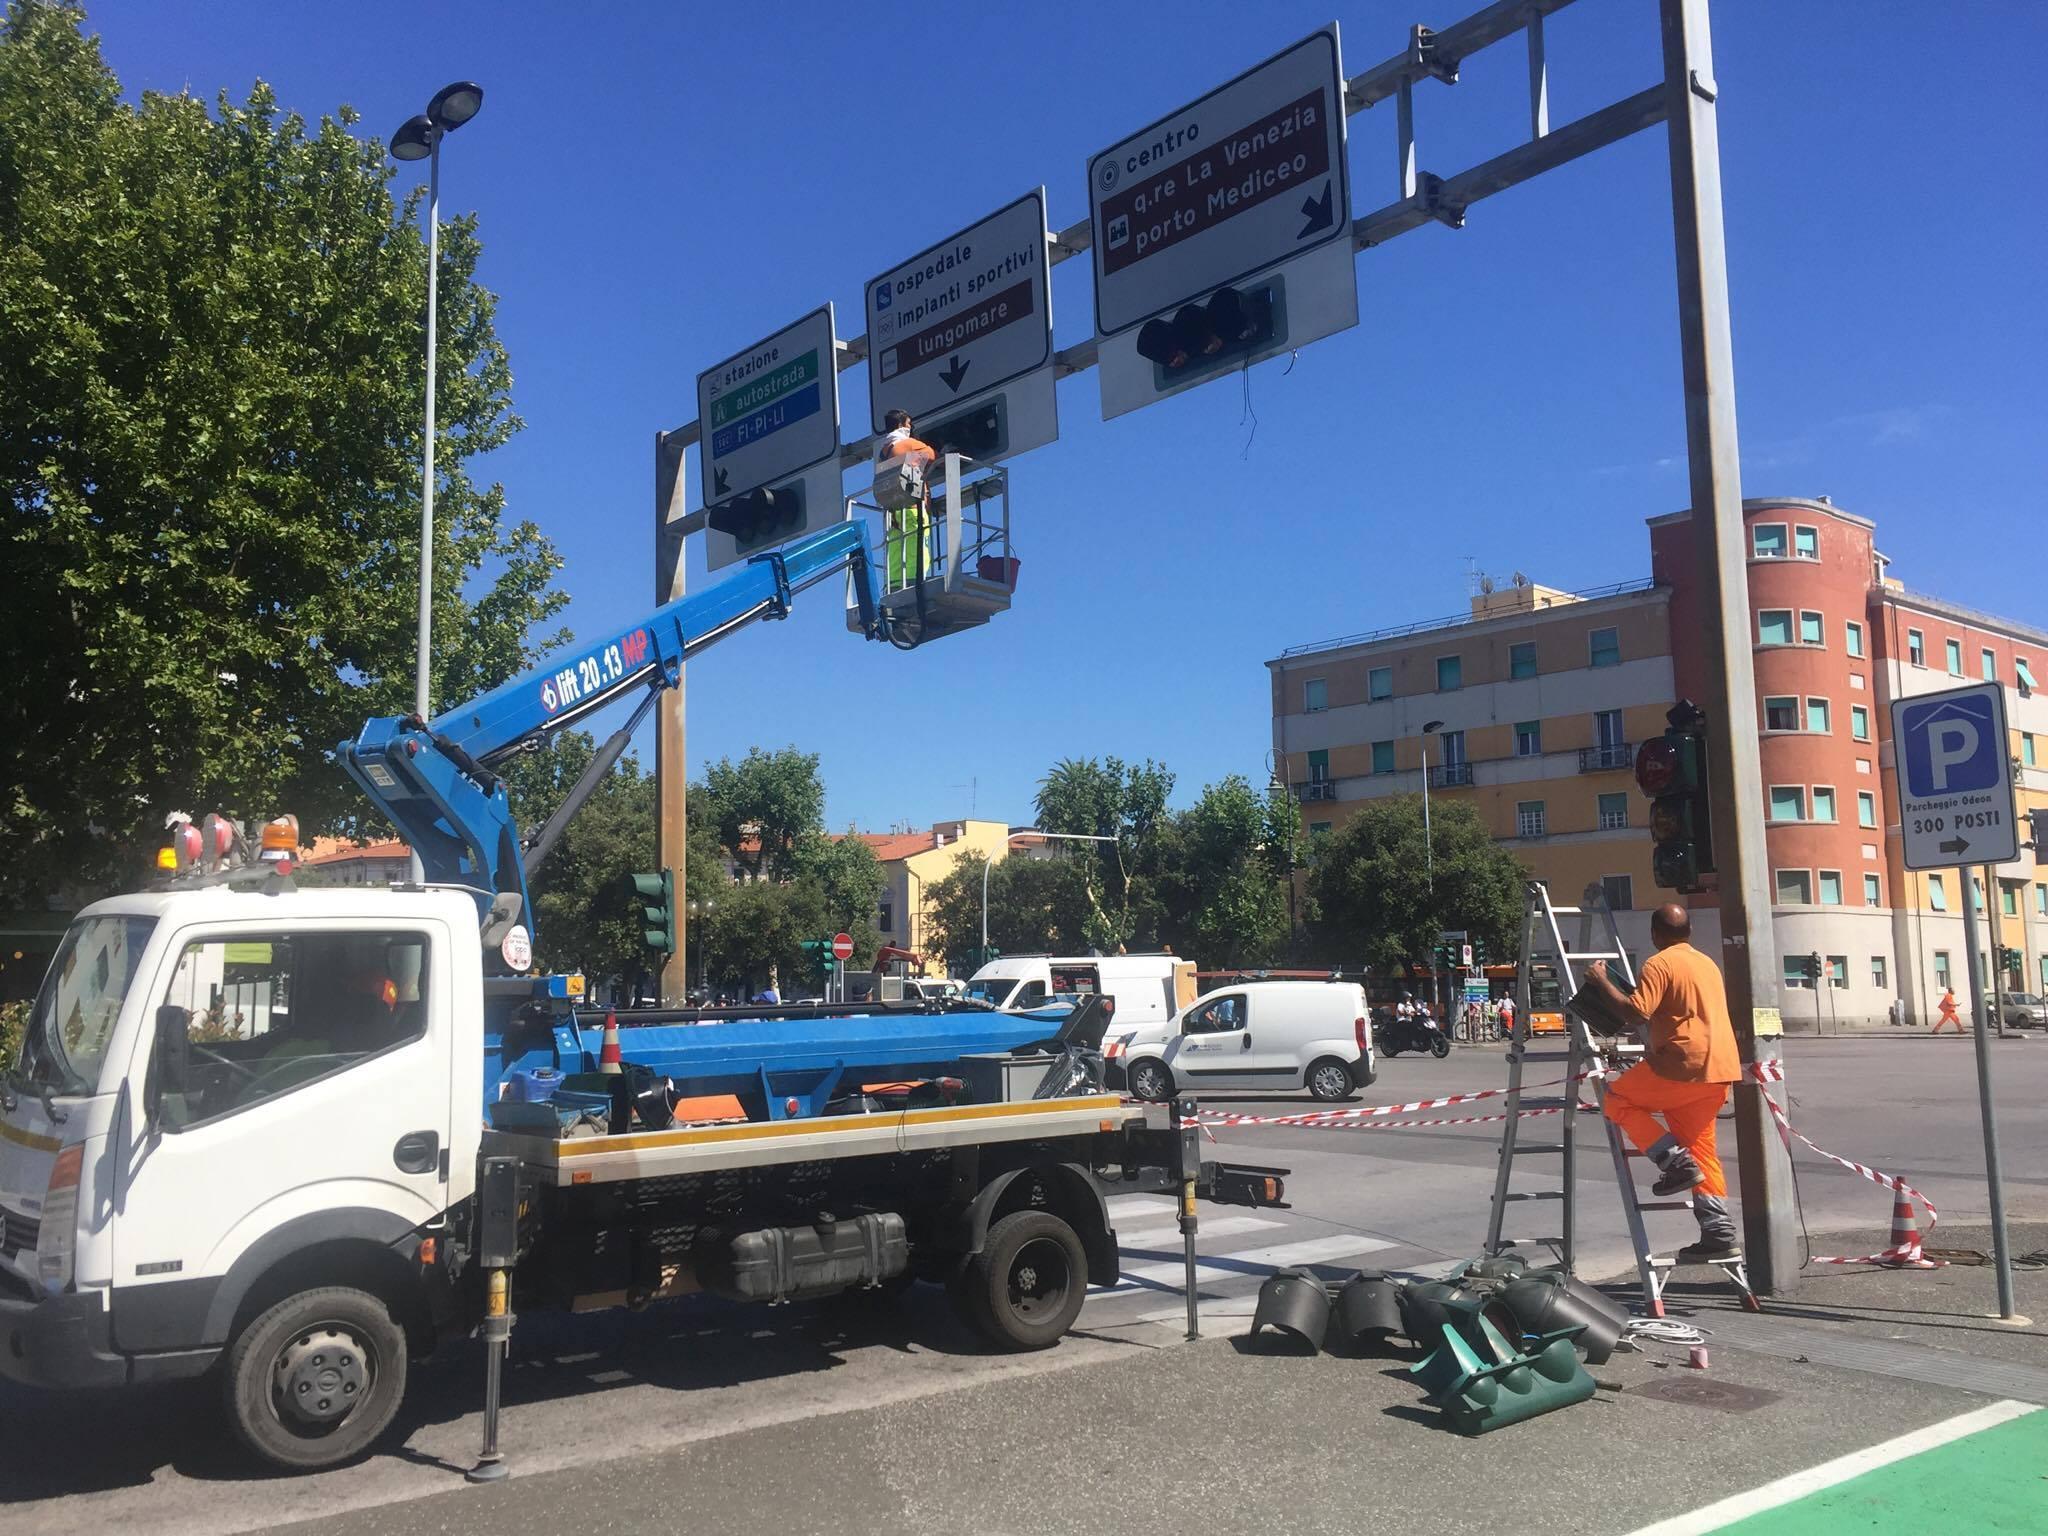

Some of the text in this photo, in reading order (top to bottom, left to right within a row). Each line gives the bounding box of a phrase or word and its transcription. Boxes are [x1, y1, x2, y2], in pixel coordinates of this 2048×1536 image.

[1126, 123, 1200, 174] centro
[1134, 105, 1317, 214] q.re La Venezia
[1135, 153, 1307, 254] porto Mediceo
[896, 245, 972, 295] ospedale
[897, 244, 1034, 329] impianti sportivi
[917, 301, 1008, 356] lungomare
[725, 347, 779, 385] stazione
[736, 364, 805, 410] autostrada
[621, 628, 648, 669] MP
[1927, 718, 1979, 790] P
[1906, 795, 1992, 812] Parcheggio Odeon
[1913, 810, 2000, 834] 300 POSTI
